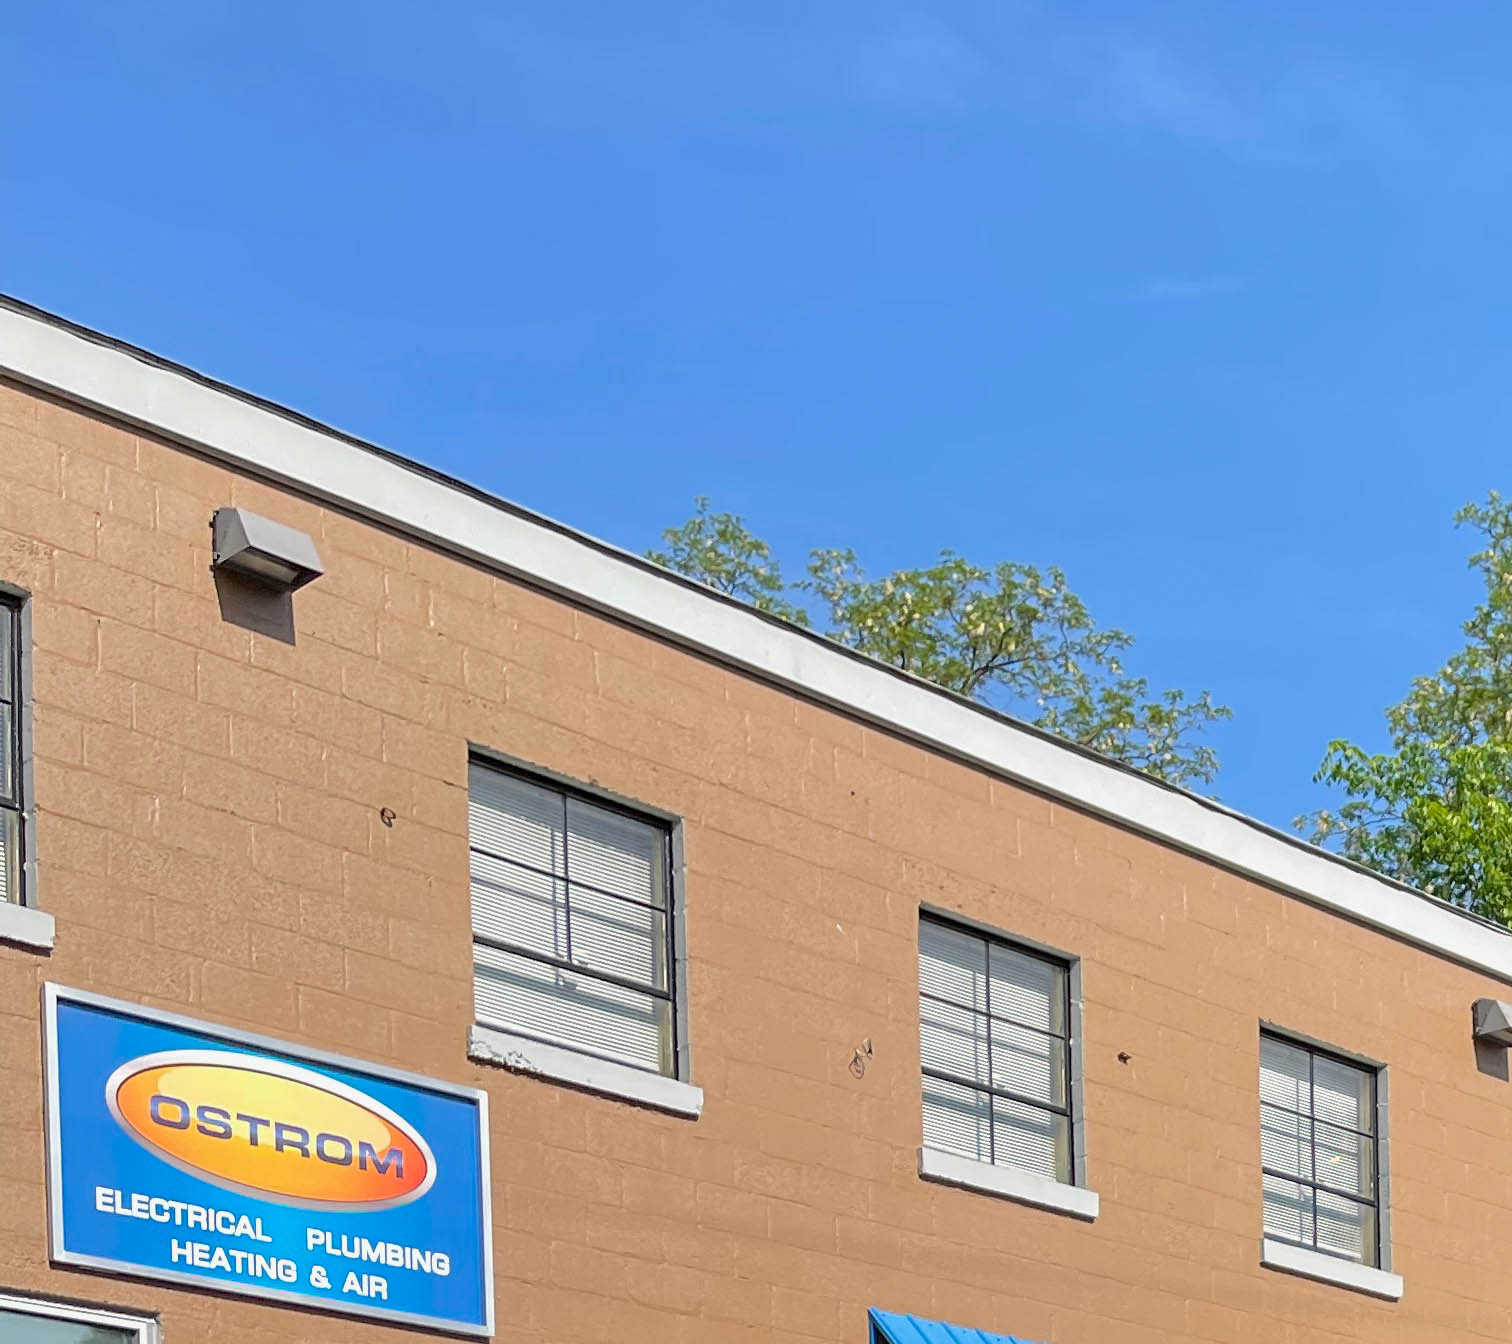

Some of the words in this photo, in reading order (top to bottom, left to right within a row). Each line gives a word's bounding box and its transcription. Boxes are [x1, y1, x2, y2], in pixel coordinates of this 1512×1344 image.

[150, 1094, 405, 1179] OSTROM
[95, 1186, 272, 1243] ELECTRICAL
[307, 1228, 450, 1277] PLUMBING
[171, 1239, 297, 1283] HEATING
[310, 1266, 331, 1289] &
[342, 1273, 388, 1300] AIR
